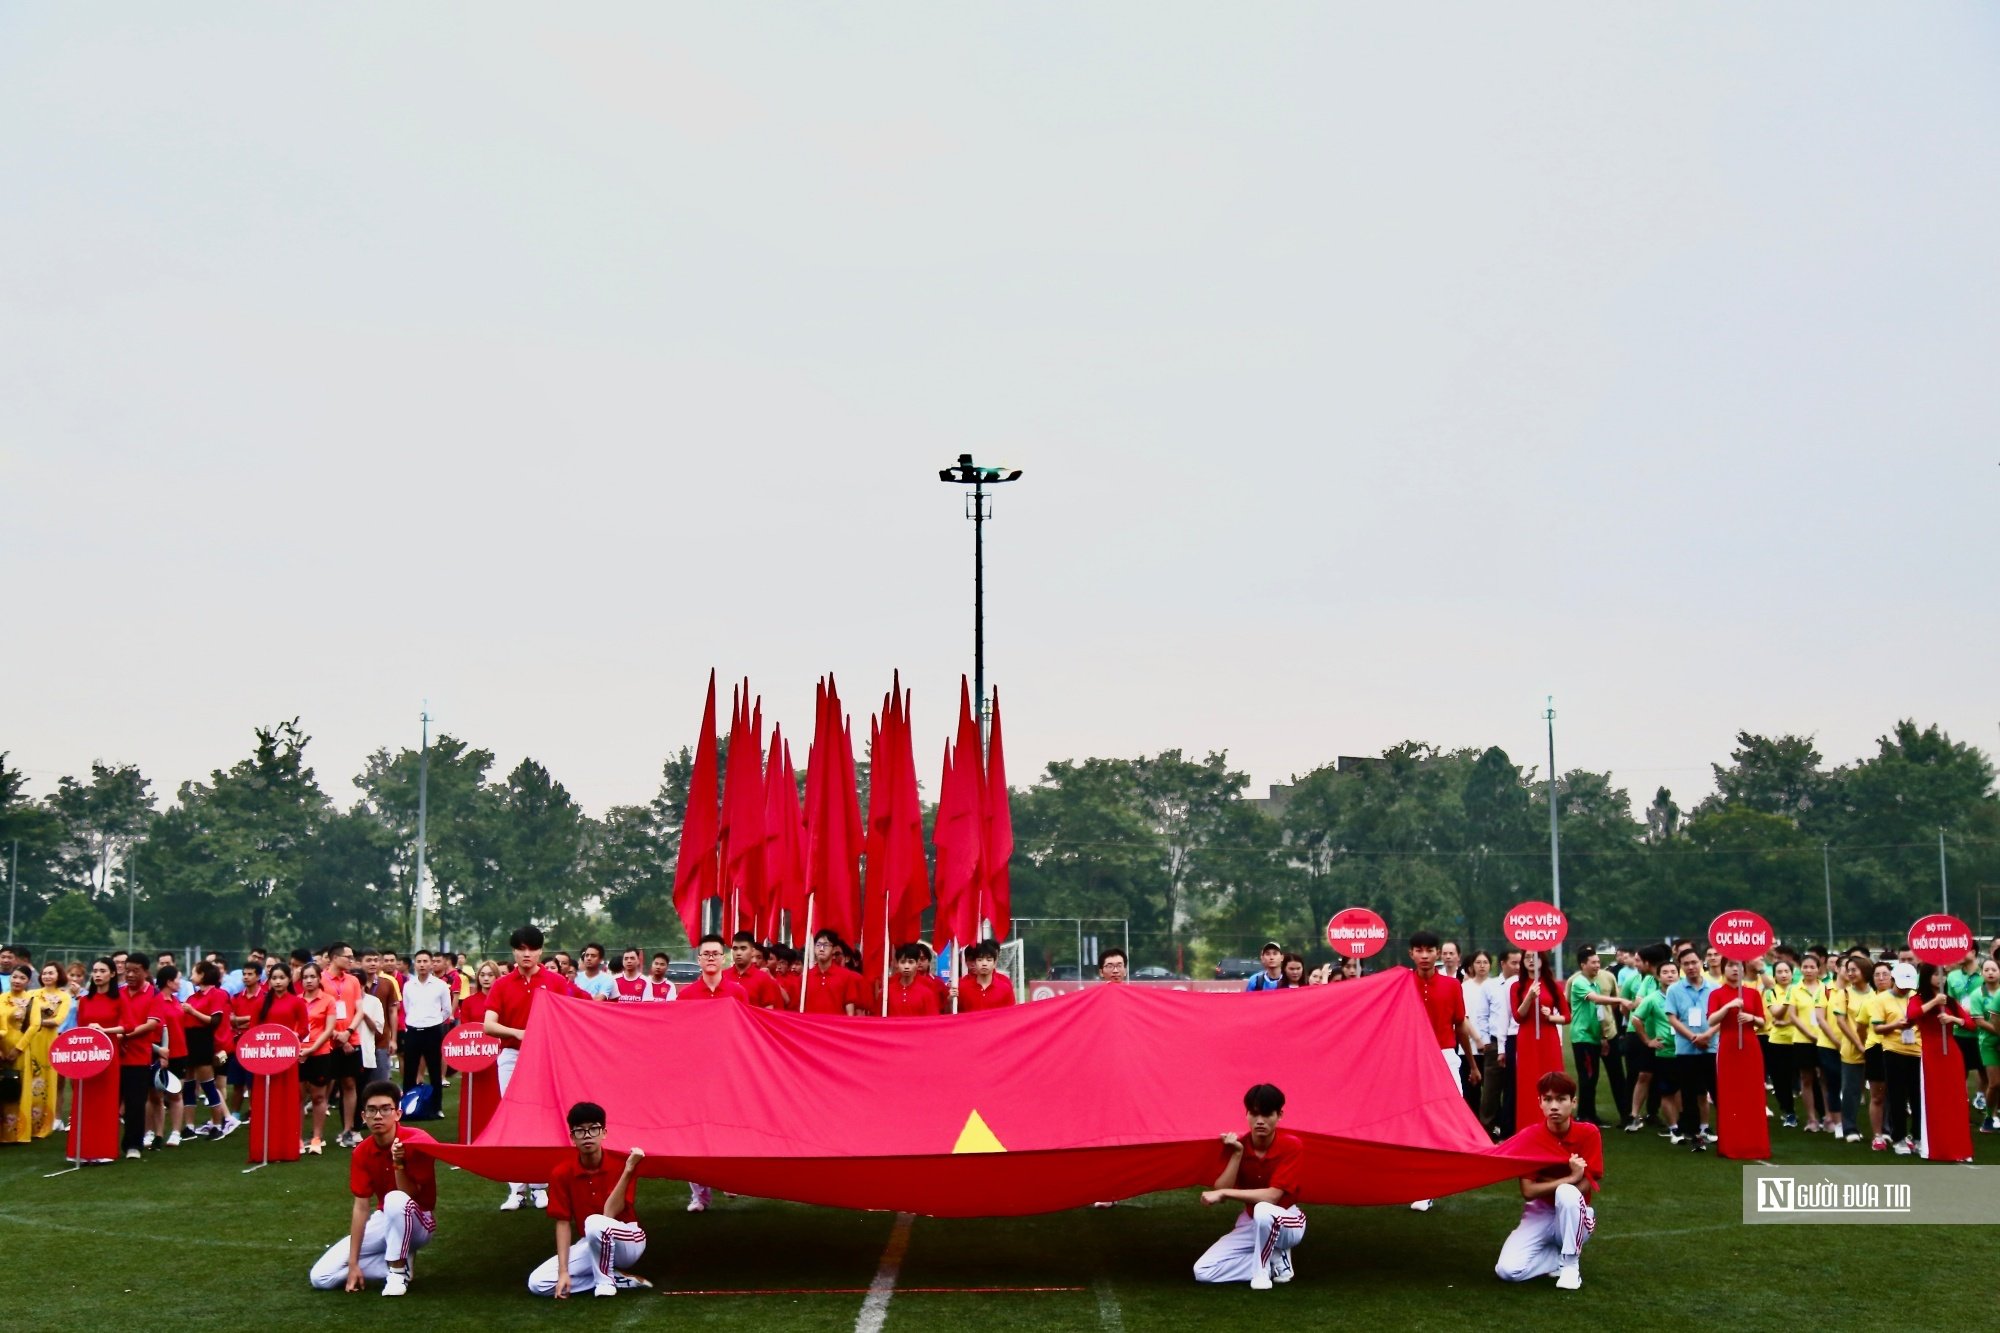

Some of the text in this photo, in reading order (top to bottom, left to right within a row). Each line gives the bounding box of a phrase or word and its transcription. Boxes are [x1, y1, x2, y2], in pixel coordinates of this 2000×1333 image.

[1509, 912, 1561, 928] HỌC VIỆN
[1727, 917, 1754, 929] BỘ TTTT
[1355, 928, 1368, 939] CAO
[1926, 922, 1952, 933] BỘ TTTT
[1514, 929, 1558, 941] CNBCVT
[1715, 930, 1766, 947] CỤC BÁO CHÍ
[1350, 942, 1366, 954] TTTT
[1912, 933, 1969, 951] KHỐI CƠ QUAN BỘ
[68, 1034, 95, 1045] SỞ TTTT
[255, 1031, 282, 1041] SỞ TTTT
[459, 1029, 484, 1040] SỞ TTTT
[240, 1042, 296, 1059] TỈNH BẮC NINH
[443, 1040, 499, 1058] TỈNH BẮC KẠN
[51, 1047, 70, 1064] TỈNH
[71, 1050, 88, 1063] CAO
